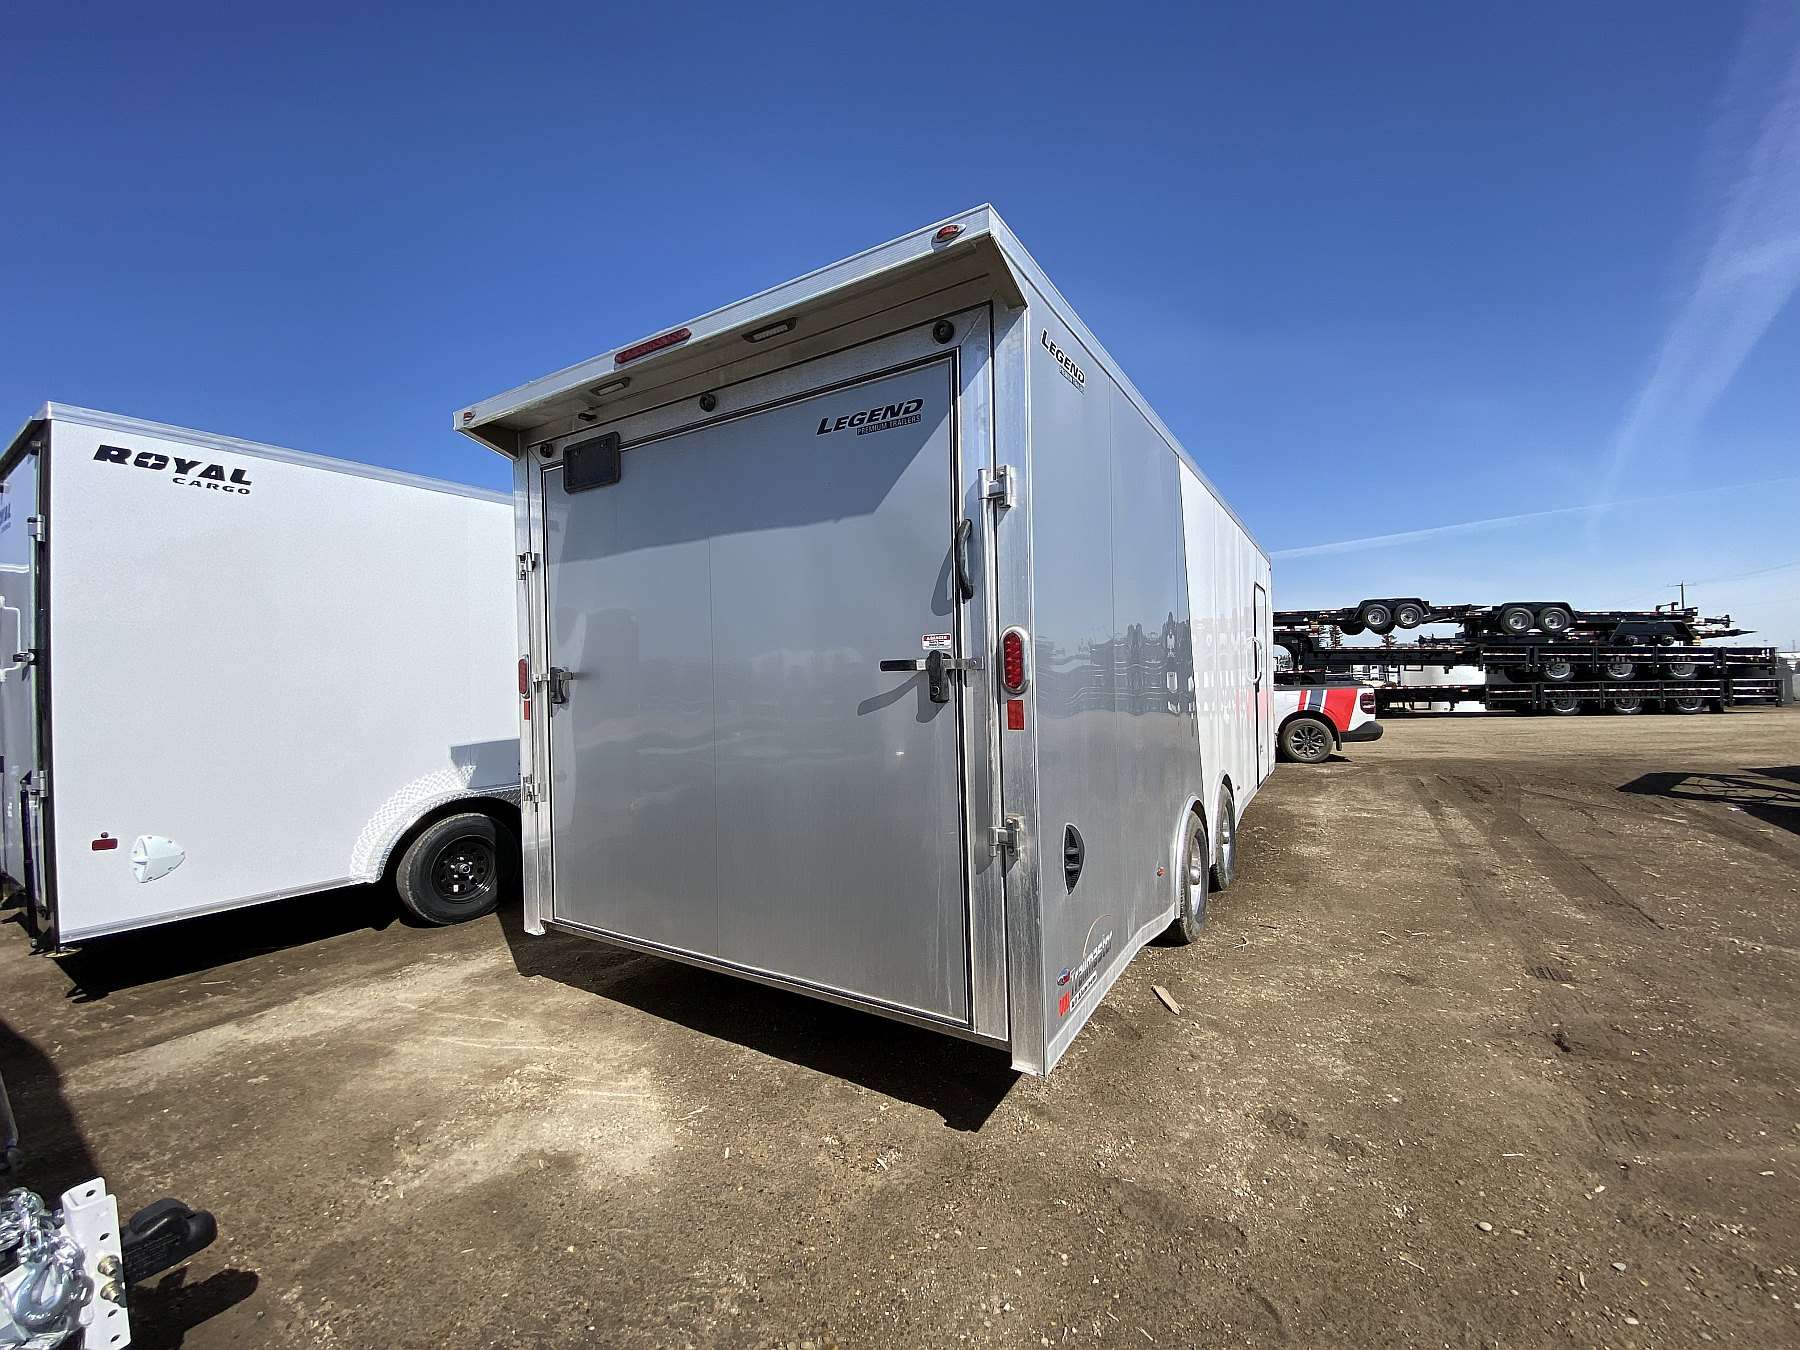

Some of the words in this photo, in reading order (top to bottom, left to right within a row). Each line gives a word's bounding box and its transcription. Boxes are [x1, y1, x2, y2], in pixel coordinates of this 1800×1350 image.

[1041, 329, 1085, 384] LEGEND
[817, 399, 924, 435] LEGEND
[857, 421, 887, 435] PREMIUM
[889, 414, 921, 428] TRAILERS
[93, 444, 252, 486] ROYAL
[172, 477, 250, 494] CARGO
